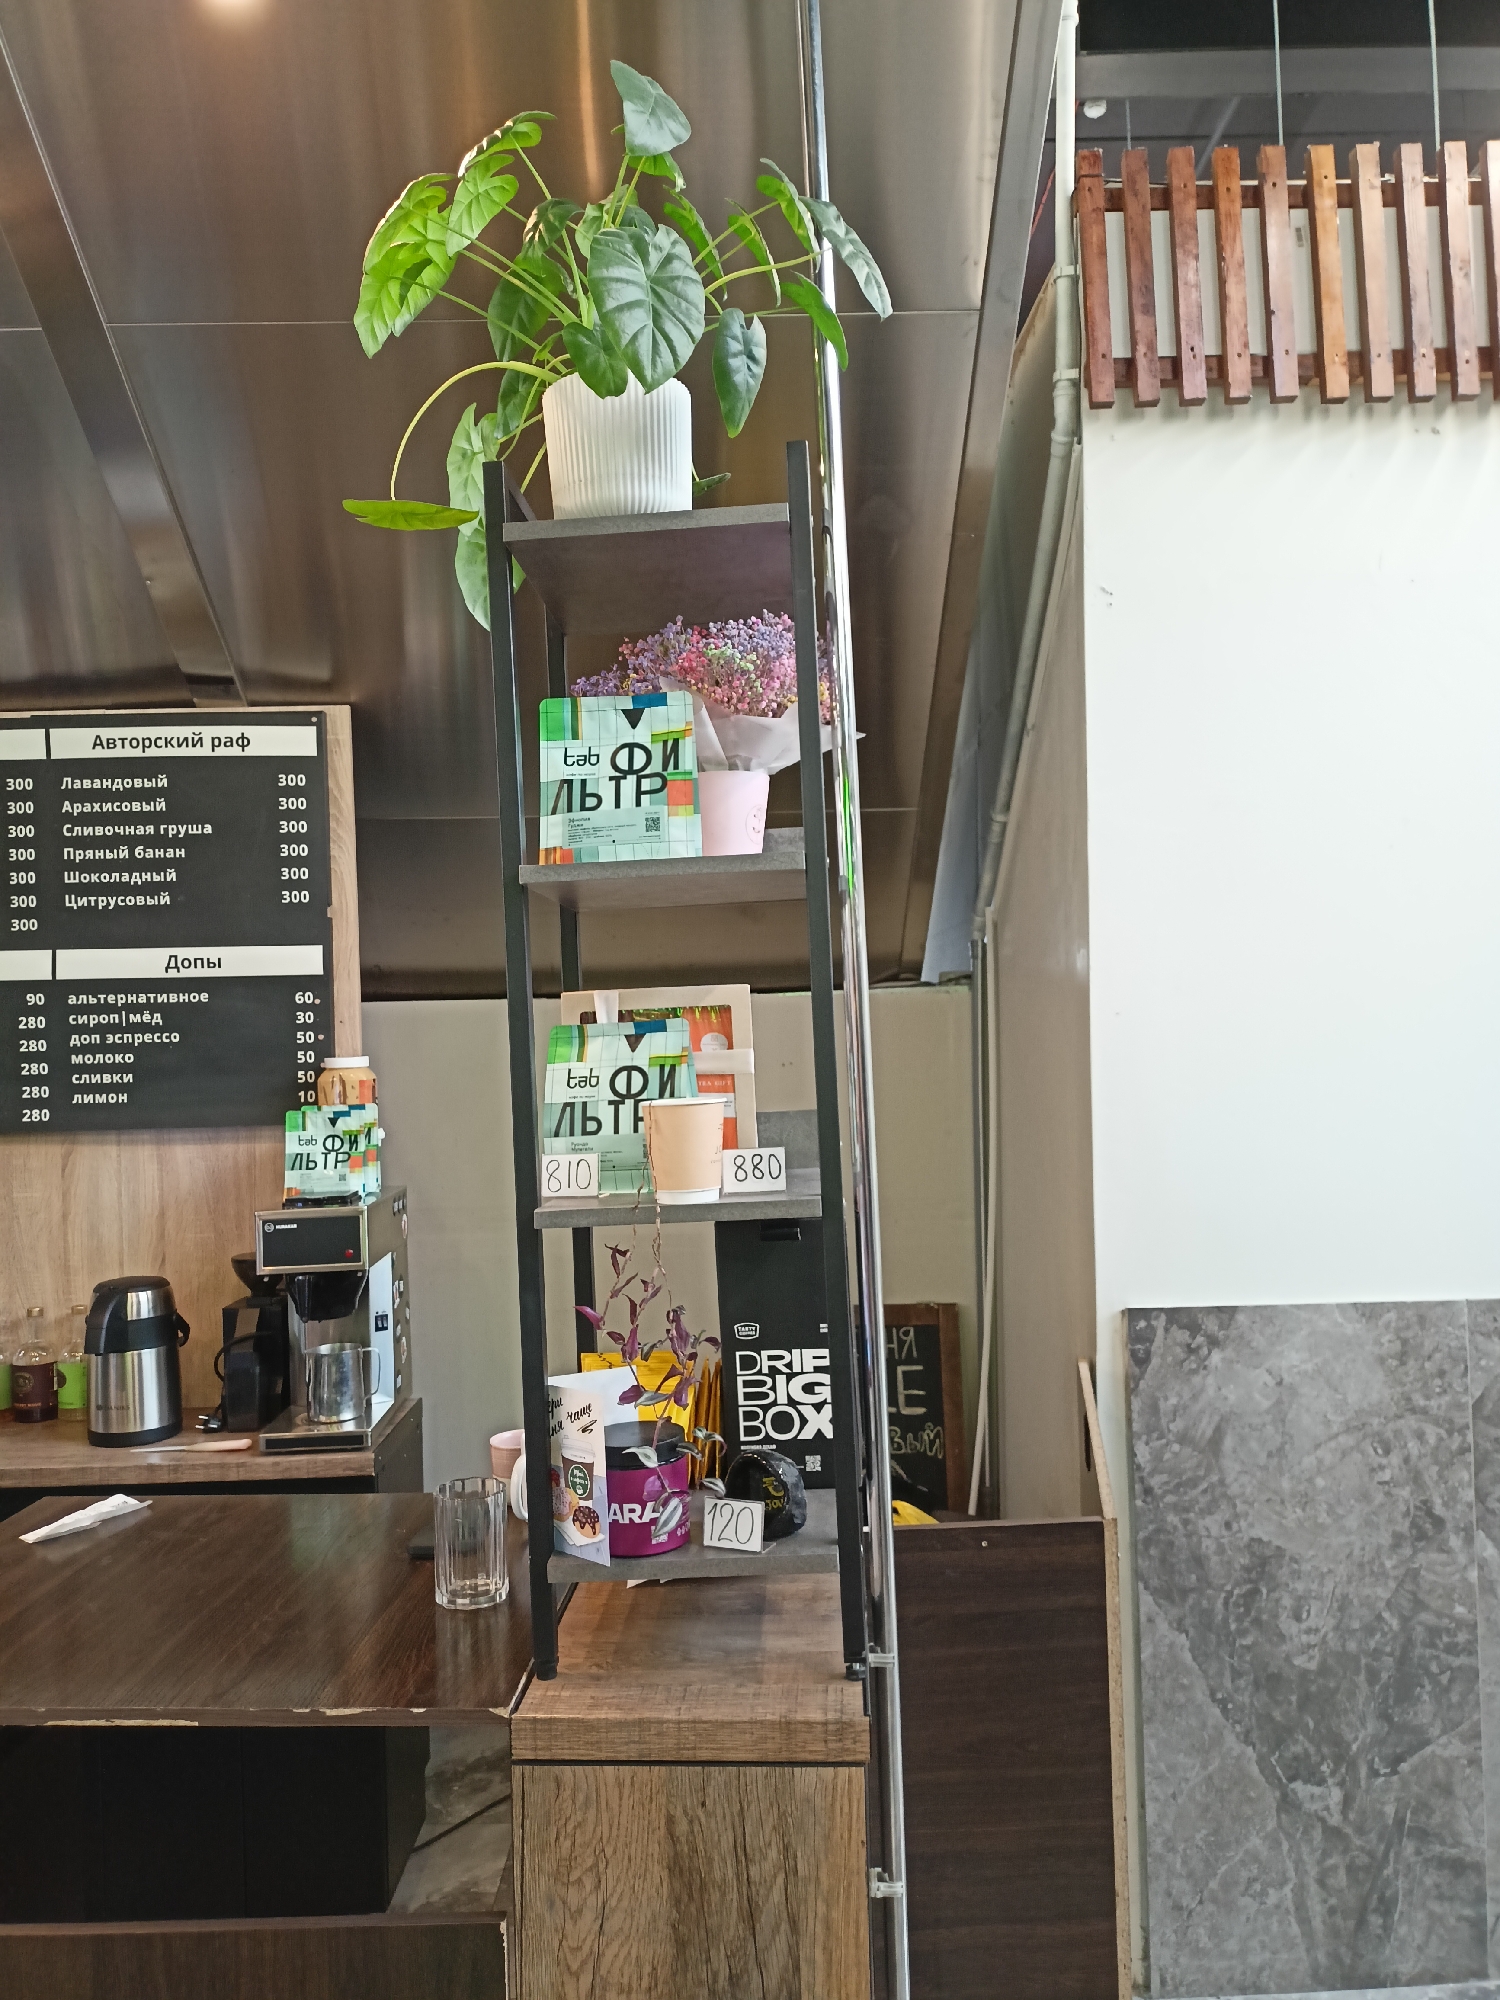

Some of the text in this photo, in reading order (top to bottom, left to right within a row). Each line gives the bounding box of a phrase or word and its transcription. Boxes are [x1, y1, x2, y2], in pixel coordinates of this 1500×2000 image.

[91, 731, 251, 754] Авторский раф
[610, 737, 680, 776] ФИ
[5, 777, 34, 791] 300
[60, 773, 307, 792] Лавандовый 300
[550, 771, 668, 815] ЛЬТР
[6, 801, 34, 815] 300
[61, 797, 307, 817] Арахисовый 300
[7, 824, 35, 838] 300
[62, 820, 308, 839] Сливочная груша 300
[8, 848, 36, 862] 300
[63, 843, 309, 862] Пряный банан 300
[9, 871, 36, 885] 300
[64, 867, 309, 886] Шоколадный 300
[10, 895, 37, 908] 300
[64, 890, 310, 910] Цитрусовый 300
[10, 918, 39, 932] 300
[164, 954, 222, 974] Допы
[25, 993, 45, 1006] 90
[67, 991, 314, 1008] альтернативное 60
[18, 1016, 46, 1030] 280
[295, 1011, 315, 1024] 30
[19, 1039, 47, 1052] 280
[69, 1030, 315, 1048] доп эспрессо 50
[70, 1050, 315, 1065] молоко 50
[20, 1062, 49, 1076] 280
[71, 1070, 316, 1085] сливки 50
[608, 1063, 676, 1100] ФИ
[21, 1085, 50, 1099] 280
[71, 1090, 316, 1105] лимон 10
[21, 1108, 50, 1122] 280
[322, 1134, 359, 1153] ФИ
[290, 1151, 351, 1171] ЛЬТР
[733, 1153, 782, 1182] 880
[546, 1158, 592, 1193] 810
[735, 1348, 830, 1375] DRIP
[737, 1372, 832, 1406] BIG
[738, 1403, 834, 1442] BOX
[707, 1502, 754, 1545] 120
